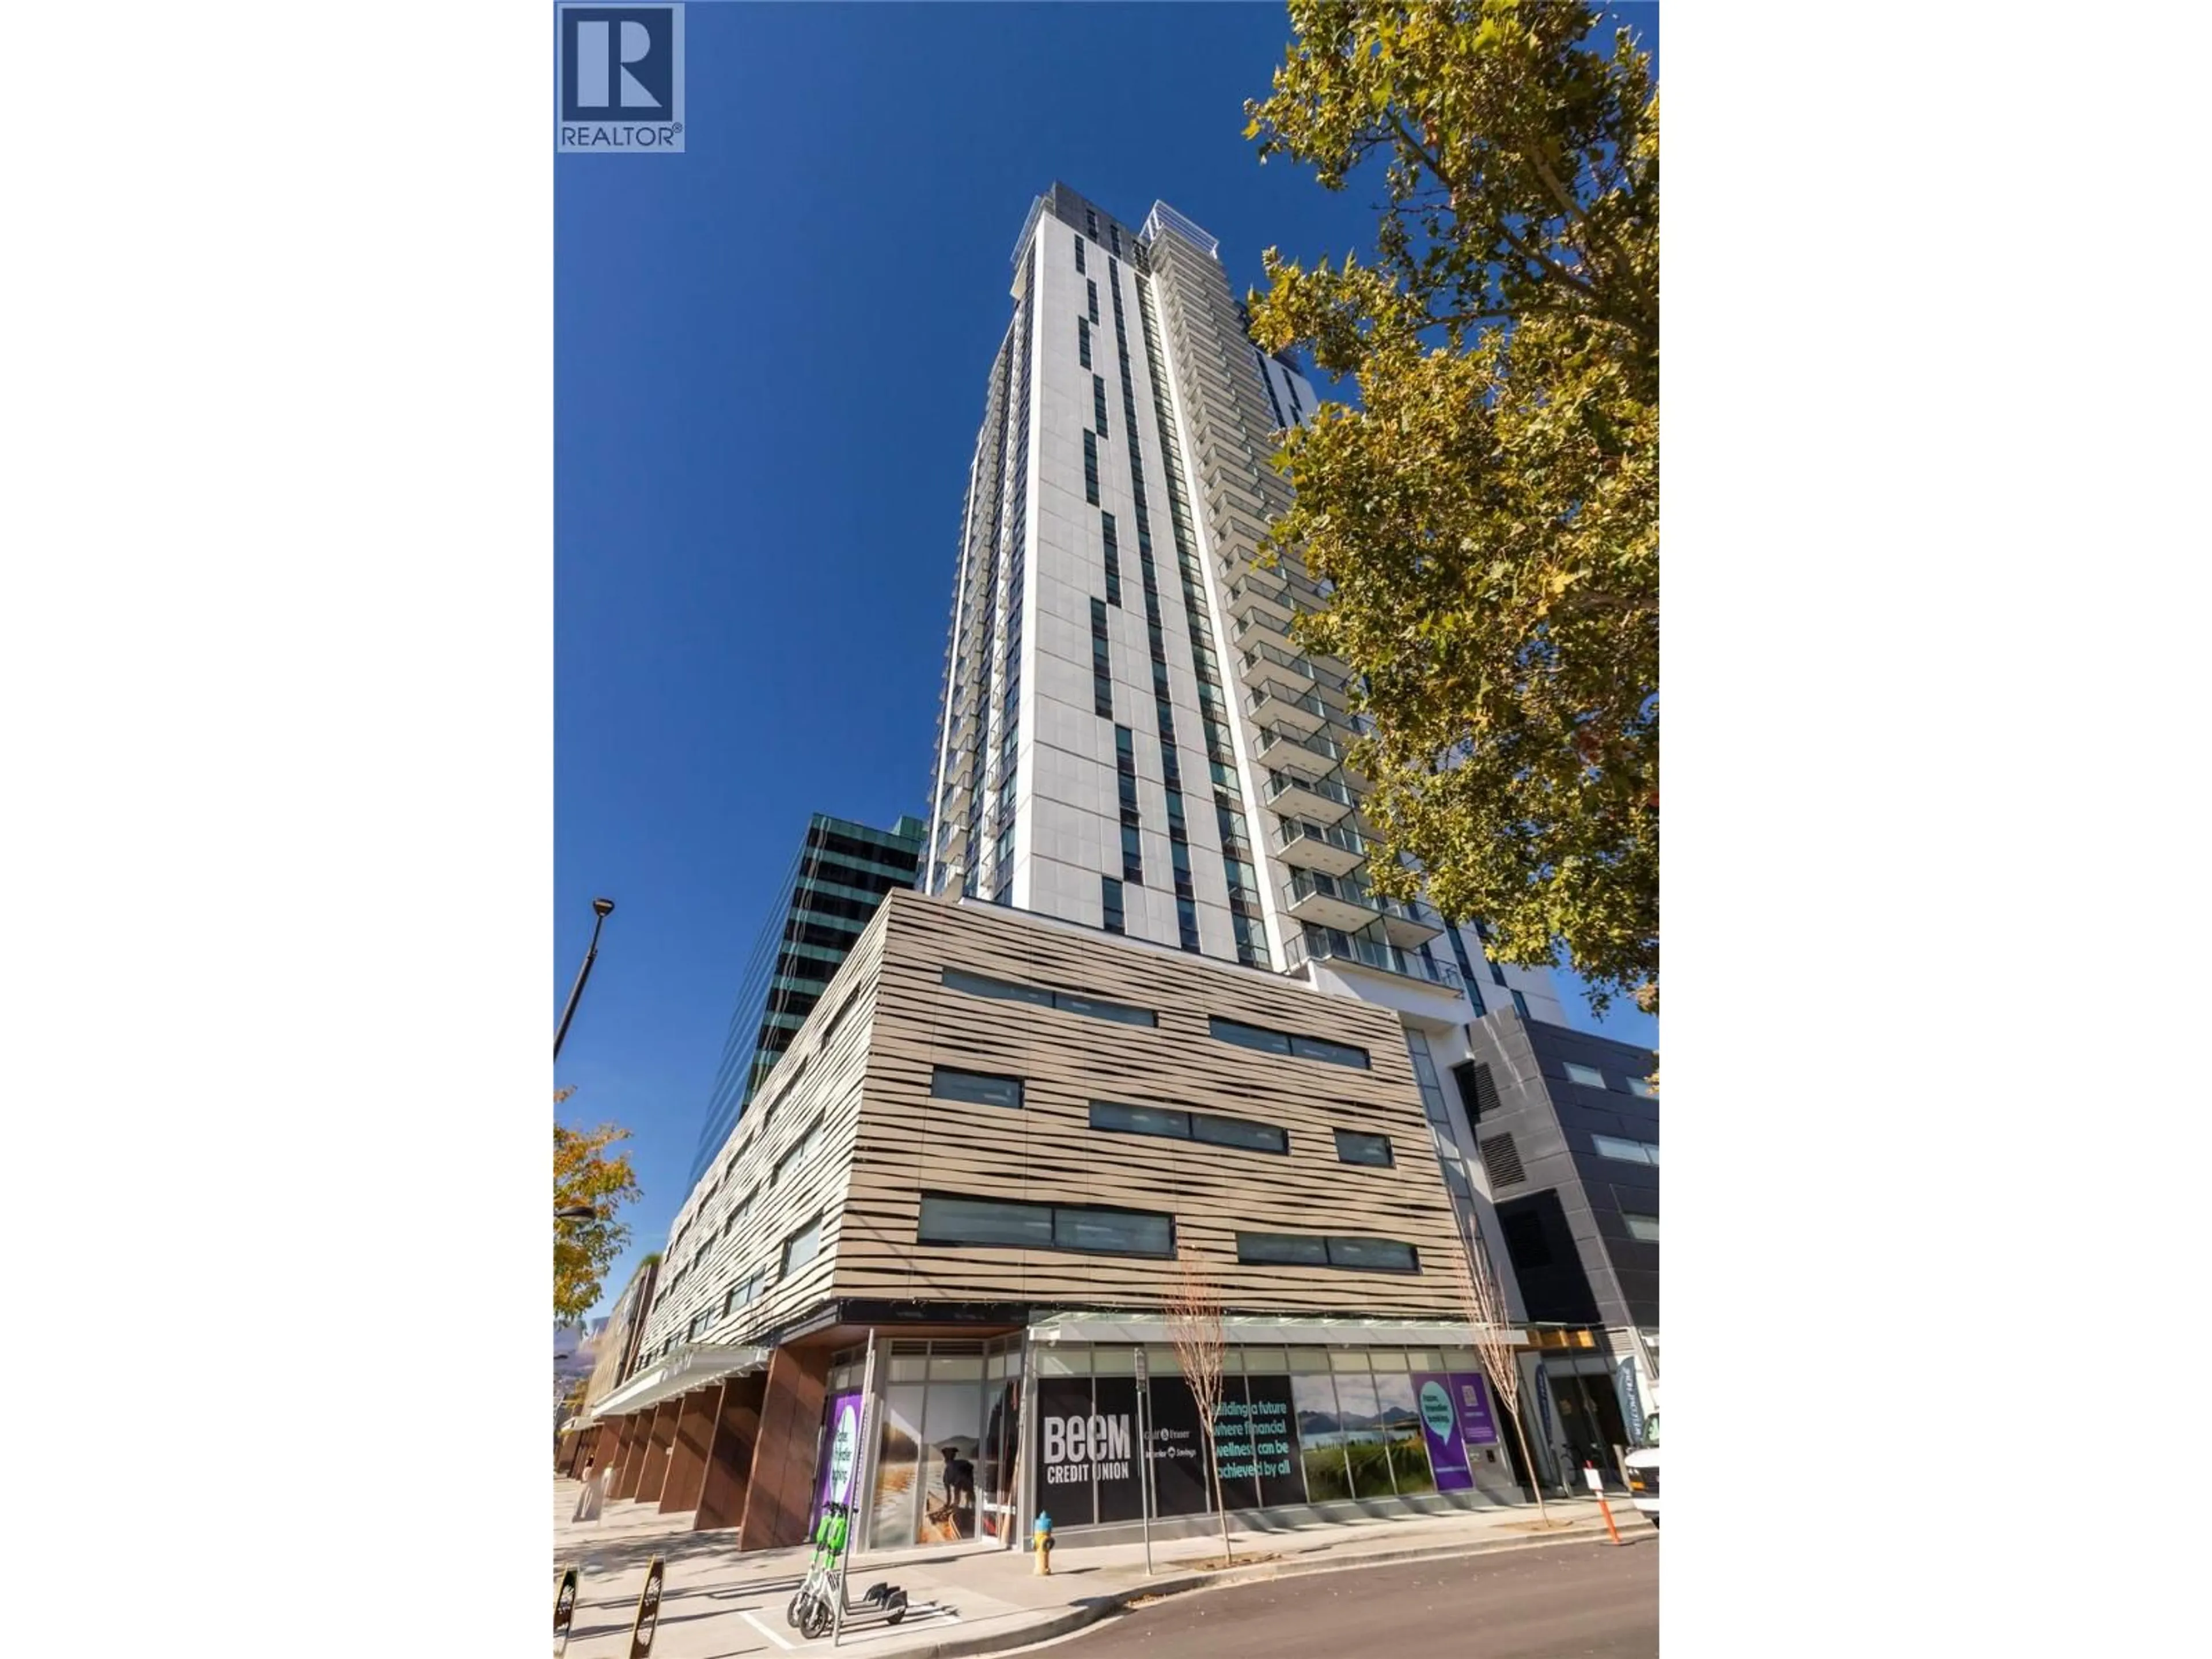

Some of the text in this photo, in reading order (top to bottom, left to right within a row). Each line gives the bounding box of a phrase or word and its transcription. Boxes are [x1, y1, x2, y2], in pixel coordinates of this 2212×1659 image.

[1251, 1404, 1257, 1415] a
[1258, 1400, 1287, 1415] future
[1258, 1443, 1275, 1455] can
[1275, 1440, 1289, 1455] be
[1047, 1461, 1129, 1484] CREDIT UNION
[1264, 1461, 1277, 1478] by
[1278, 1460, 1291, 1474] all
